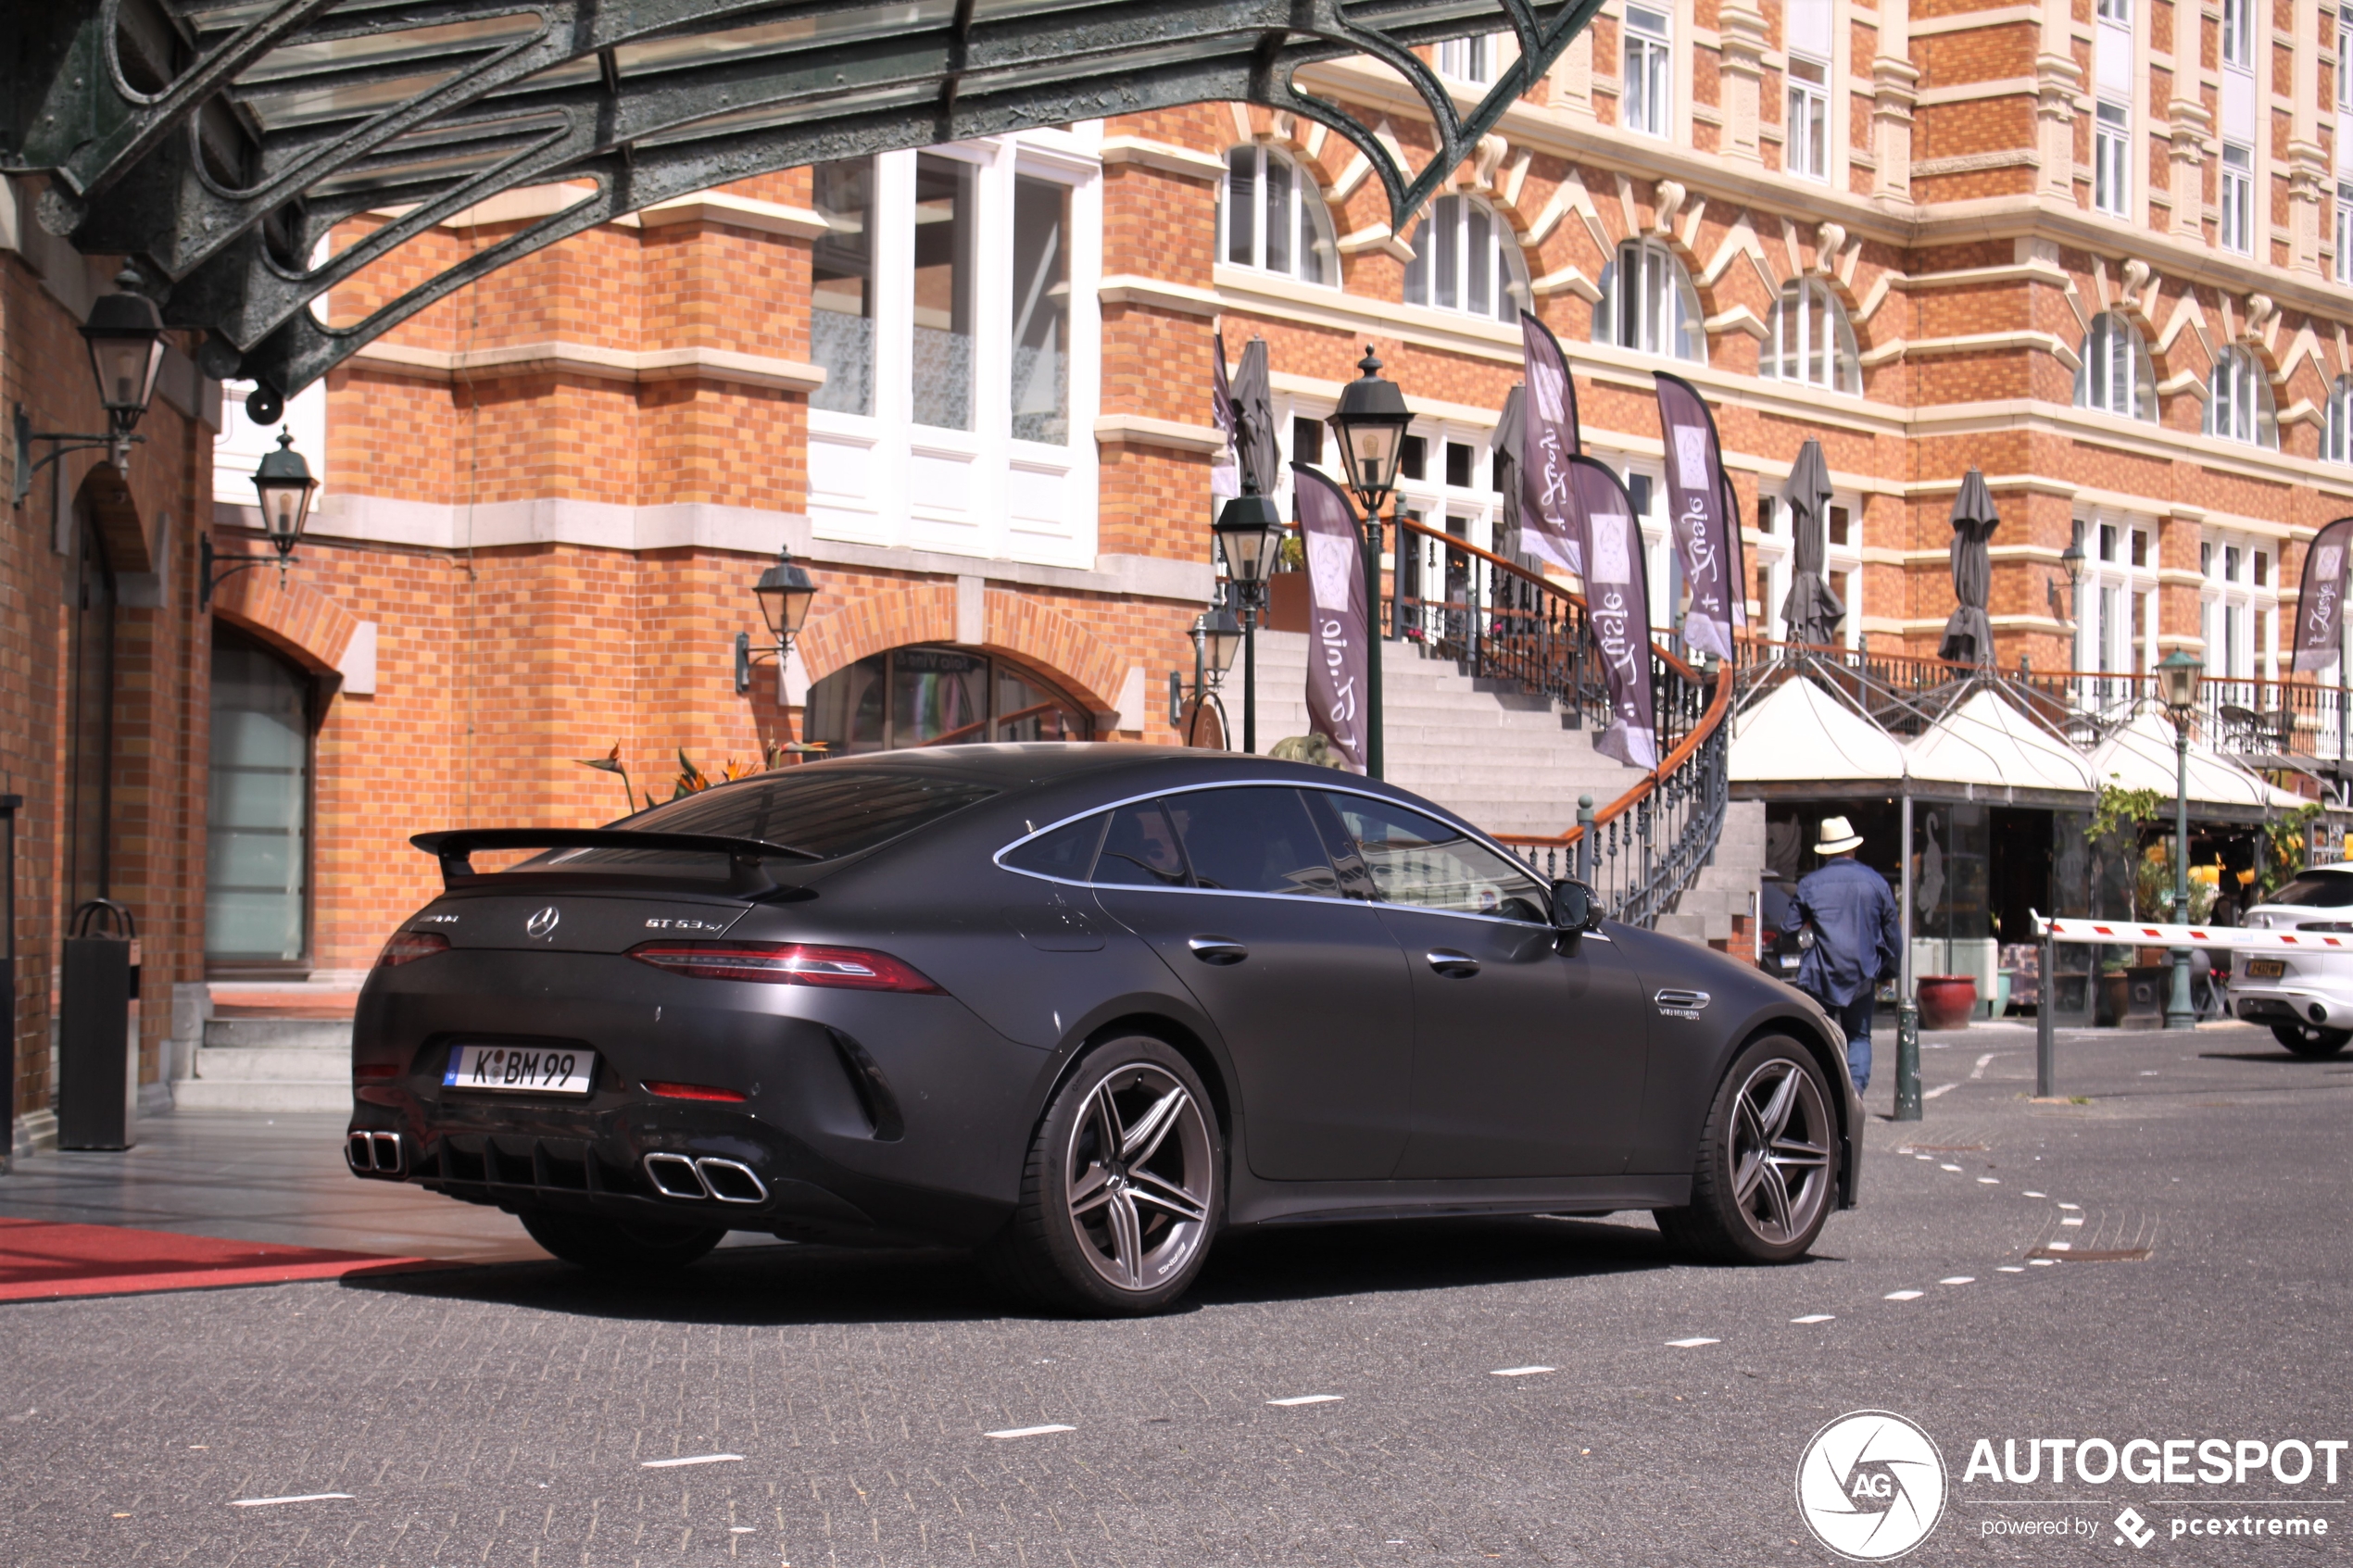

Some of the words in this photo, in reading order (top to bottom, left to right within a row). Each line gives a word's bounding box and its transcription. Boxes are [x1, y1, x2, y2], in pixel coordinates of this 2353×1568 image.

[645, 919, 673, 930] GT
[472, 1049, 494, 1085] K
[503, 1051, 541, 1085] BM
[543, 1053, 576, 1088] 99
